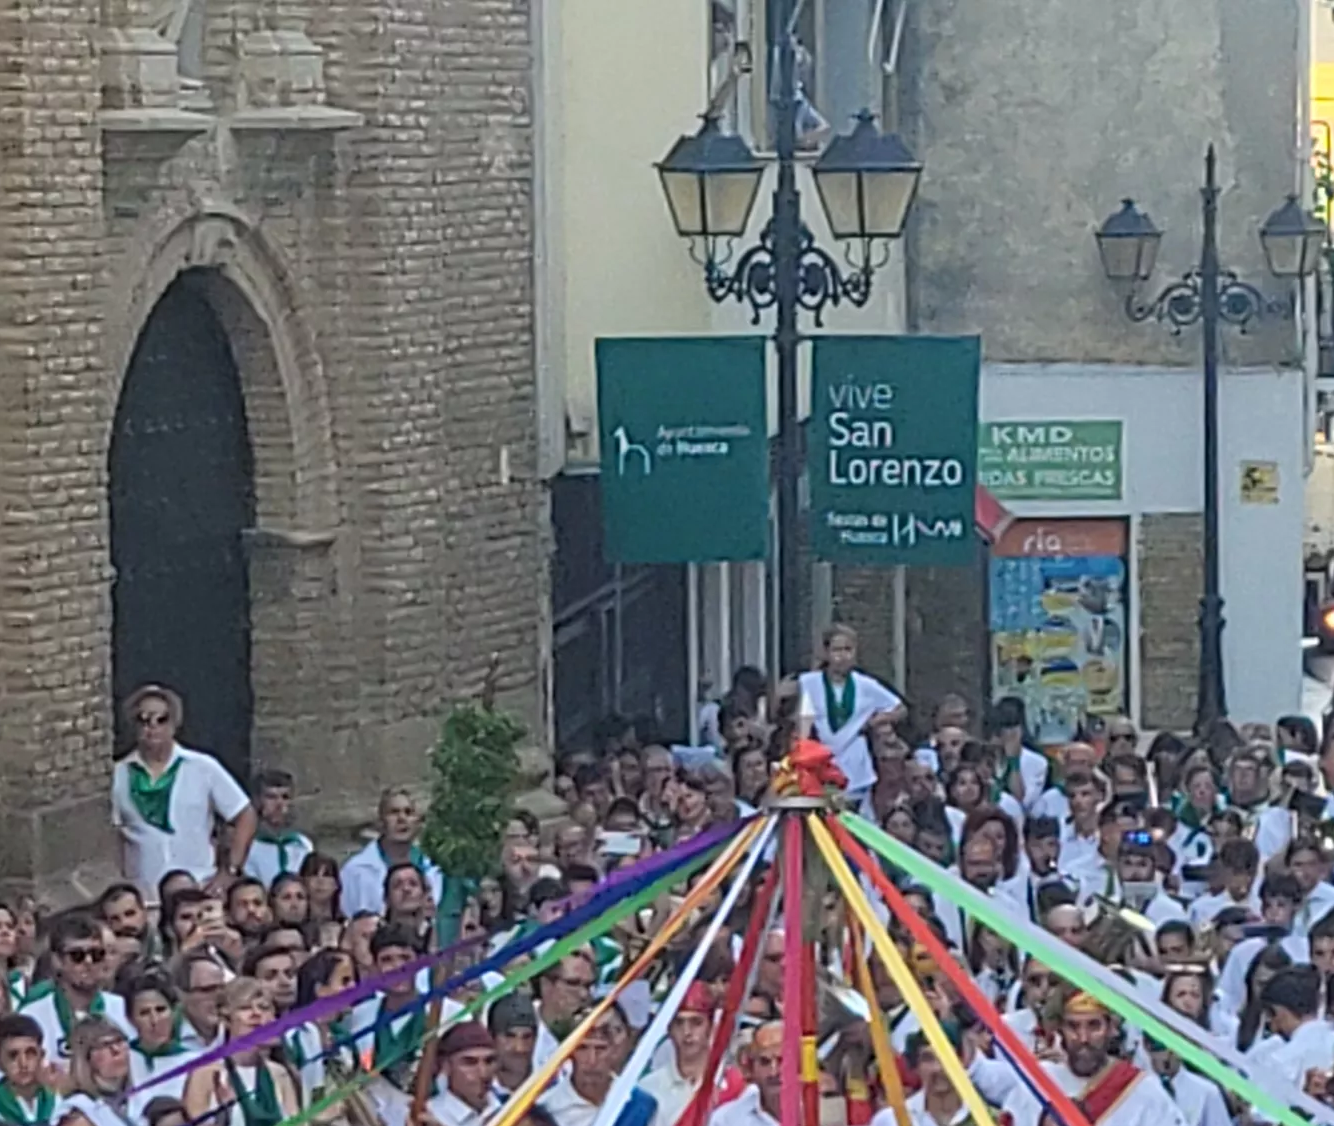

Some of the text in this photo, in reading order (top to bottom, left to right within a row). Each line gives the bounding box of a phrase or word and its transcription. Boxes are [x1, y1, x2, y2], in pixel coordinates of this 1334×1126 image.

[828, 374, 894, 409] vive
[828, 412, 893, 448] San
[991, 426, 1073, 445] KMD
[677, 441, 729, 455] Huesca
[1006, 446, 1116, 462] ALIMENTOS
[828, 451, 963, 486] Lorenzo
[1033, 469, 1116, 486] FRESCAS
